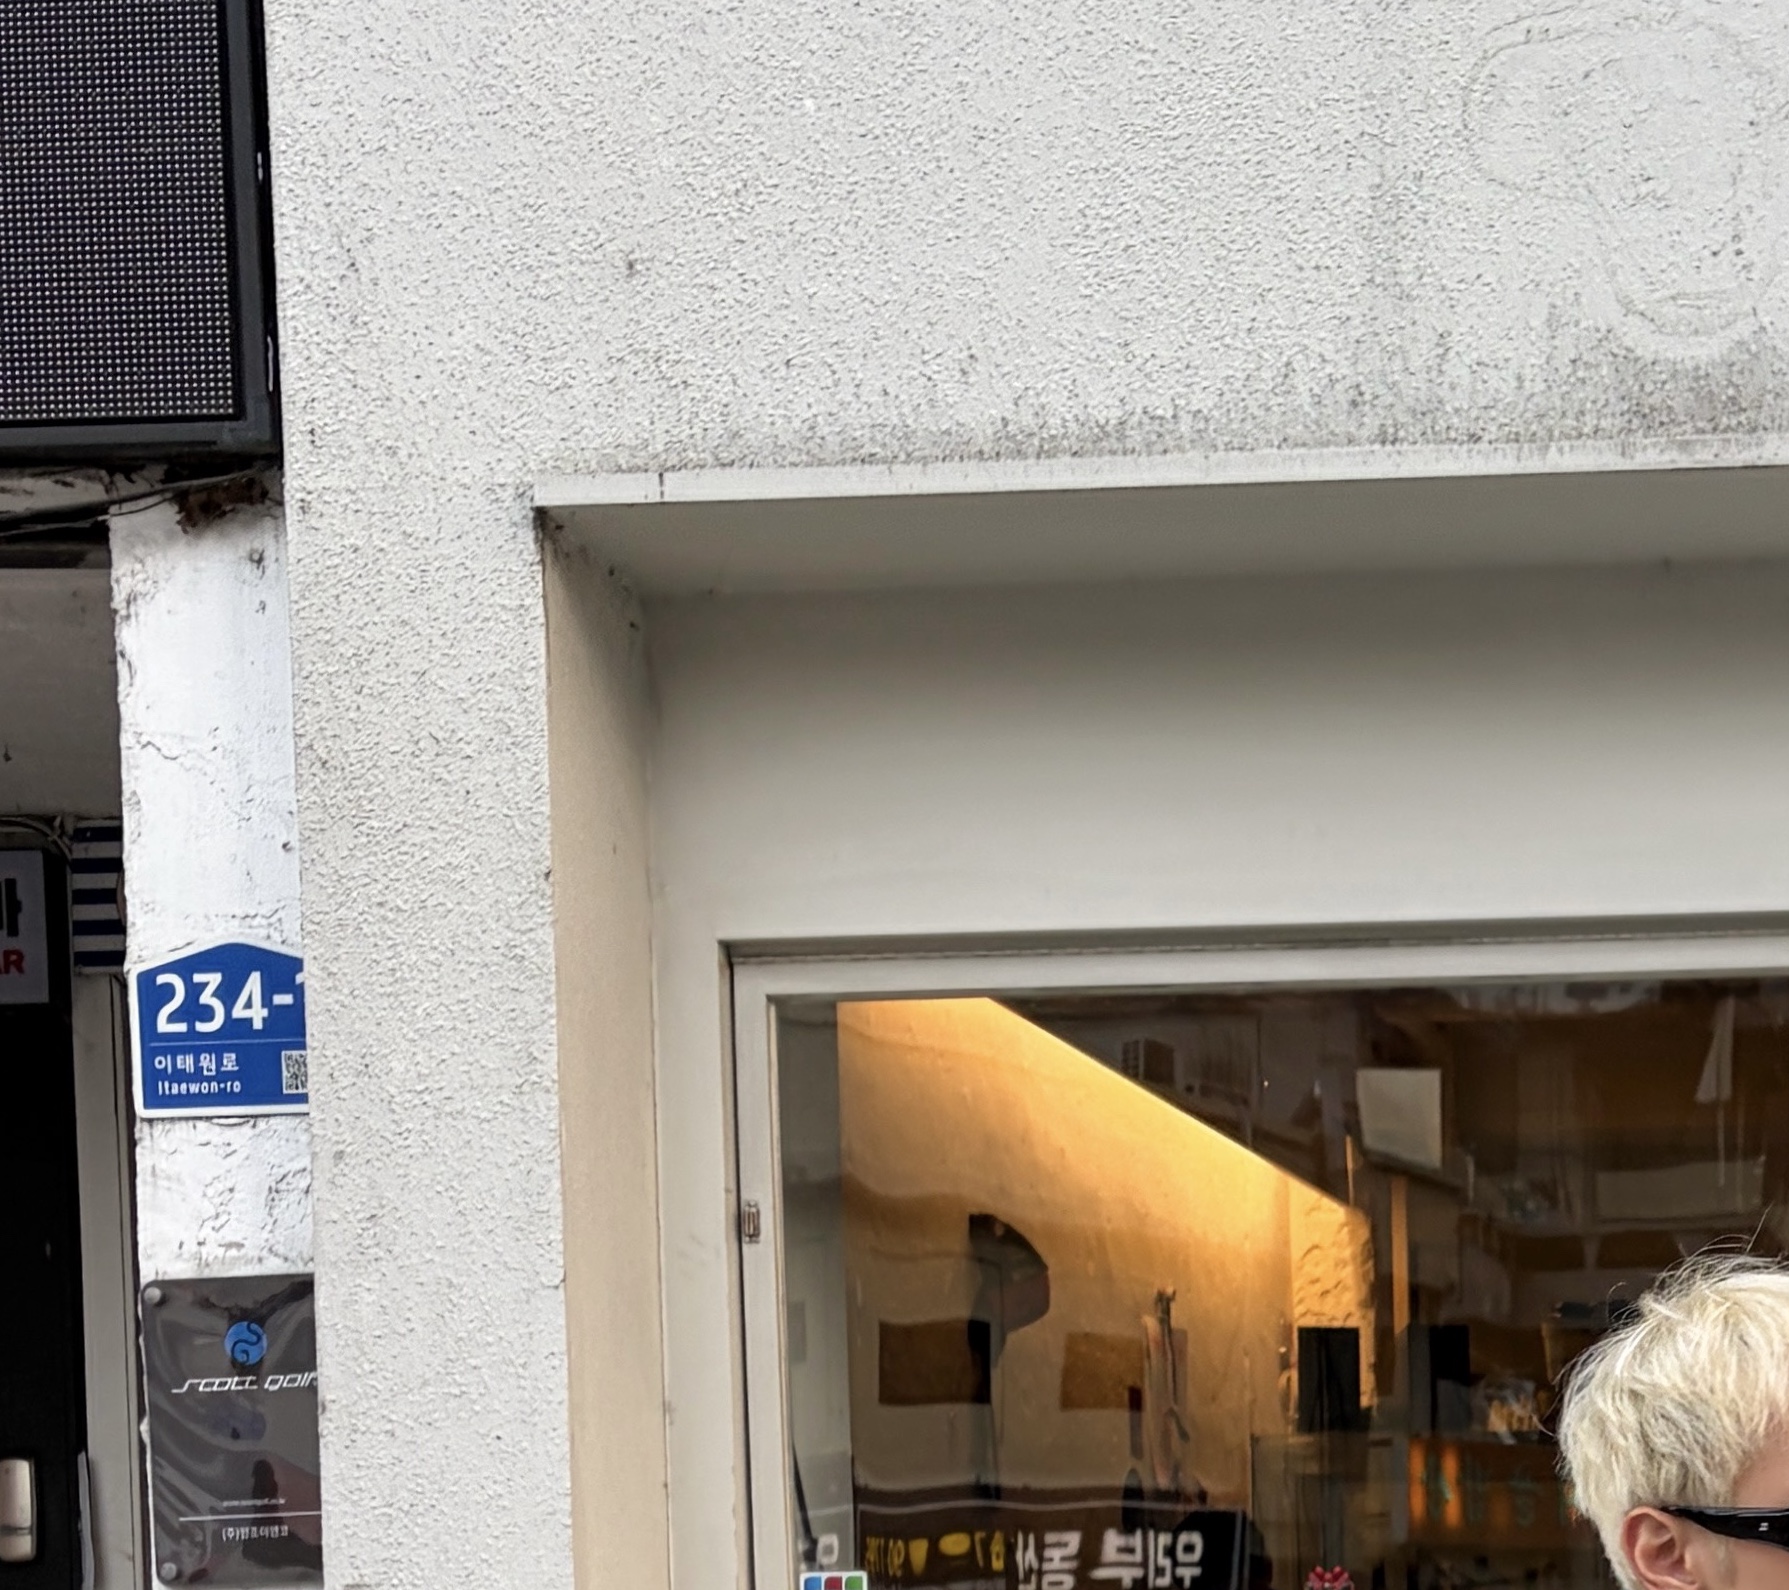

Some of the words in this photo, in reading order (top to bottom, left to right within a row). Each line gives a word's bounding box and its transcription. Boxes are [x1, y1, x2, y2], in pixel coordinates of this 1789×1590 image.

[155, 971, 305, 1033] 234-
[154, 1052, 239, 1076] 이태원로
[158, 1080, 242, 1096] Itaewon-ro
